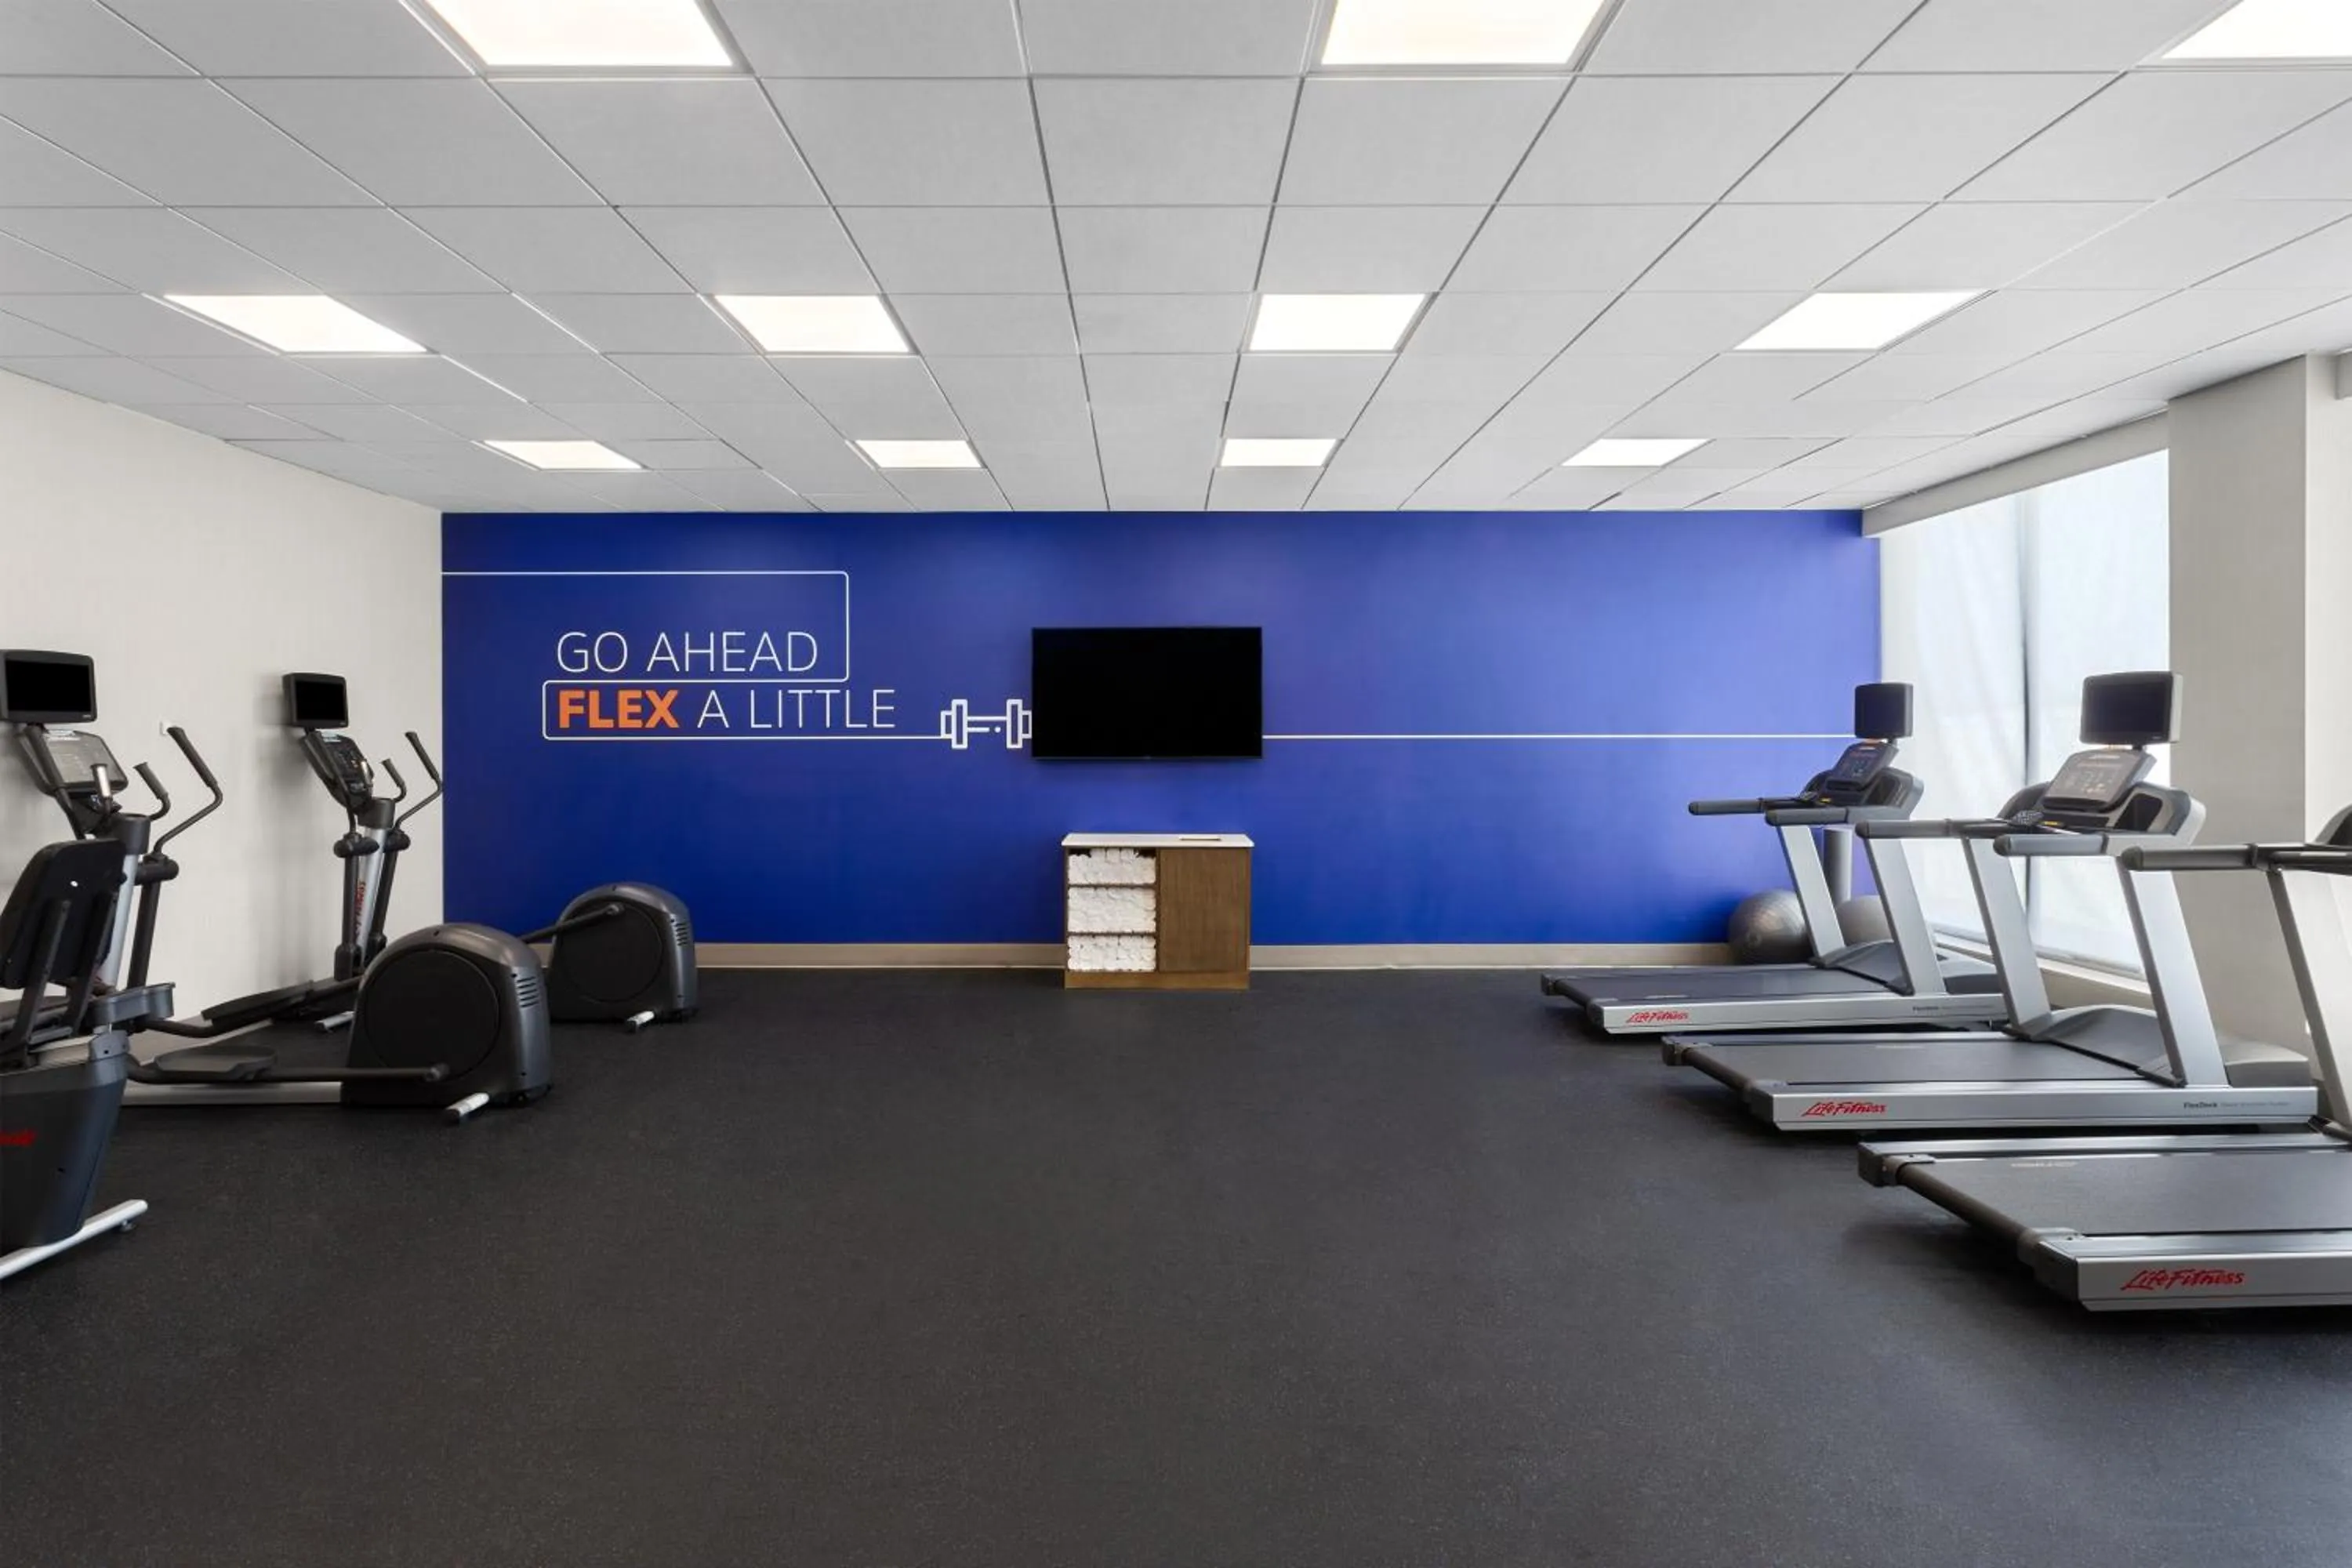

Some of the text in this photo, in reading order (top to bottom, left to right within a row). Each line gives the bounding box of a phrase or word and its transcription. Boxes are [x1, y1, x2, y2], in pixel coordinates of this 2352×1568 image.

[557, 631, 818, 673] GO AHEAD
[557, 689, 895, 729] FLEX A LITTLE
